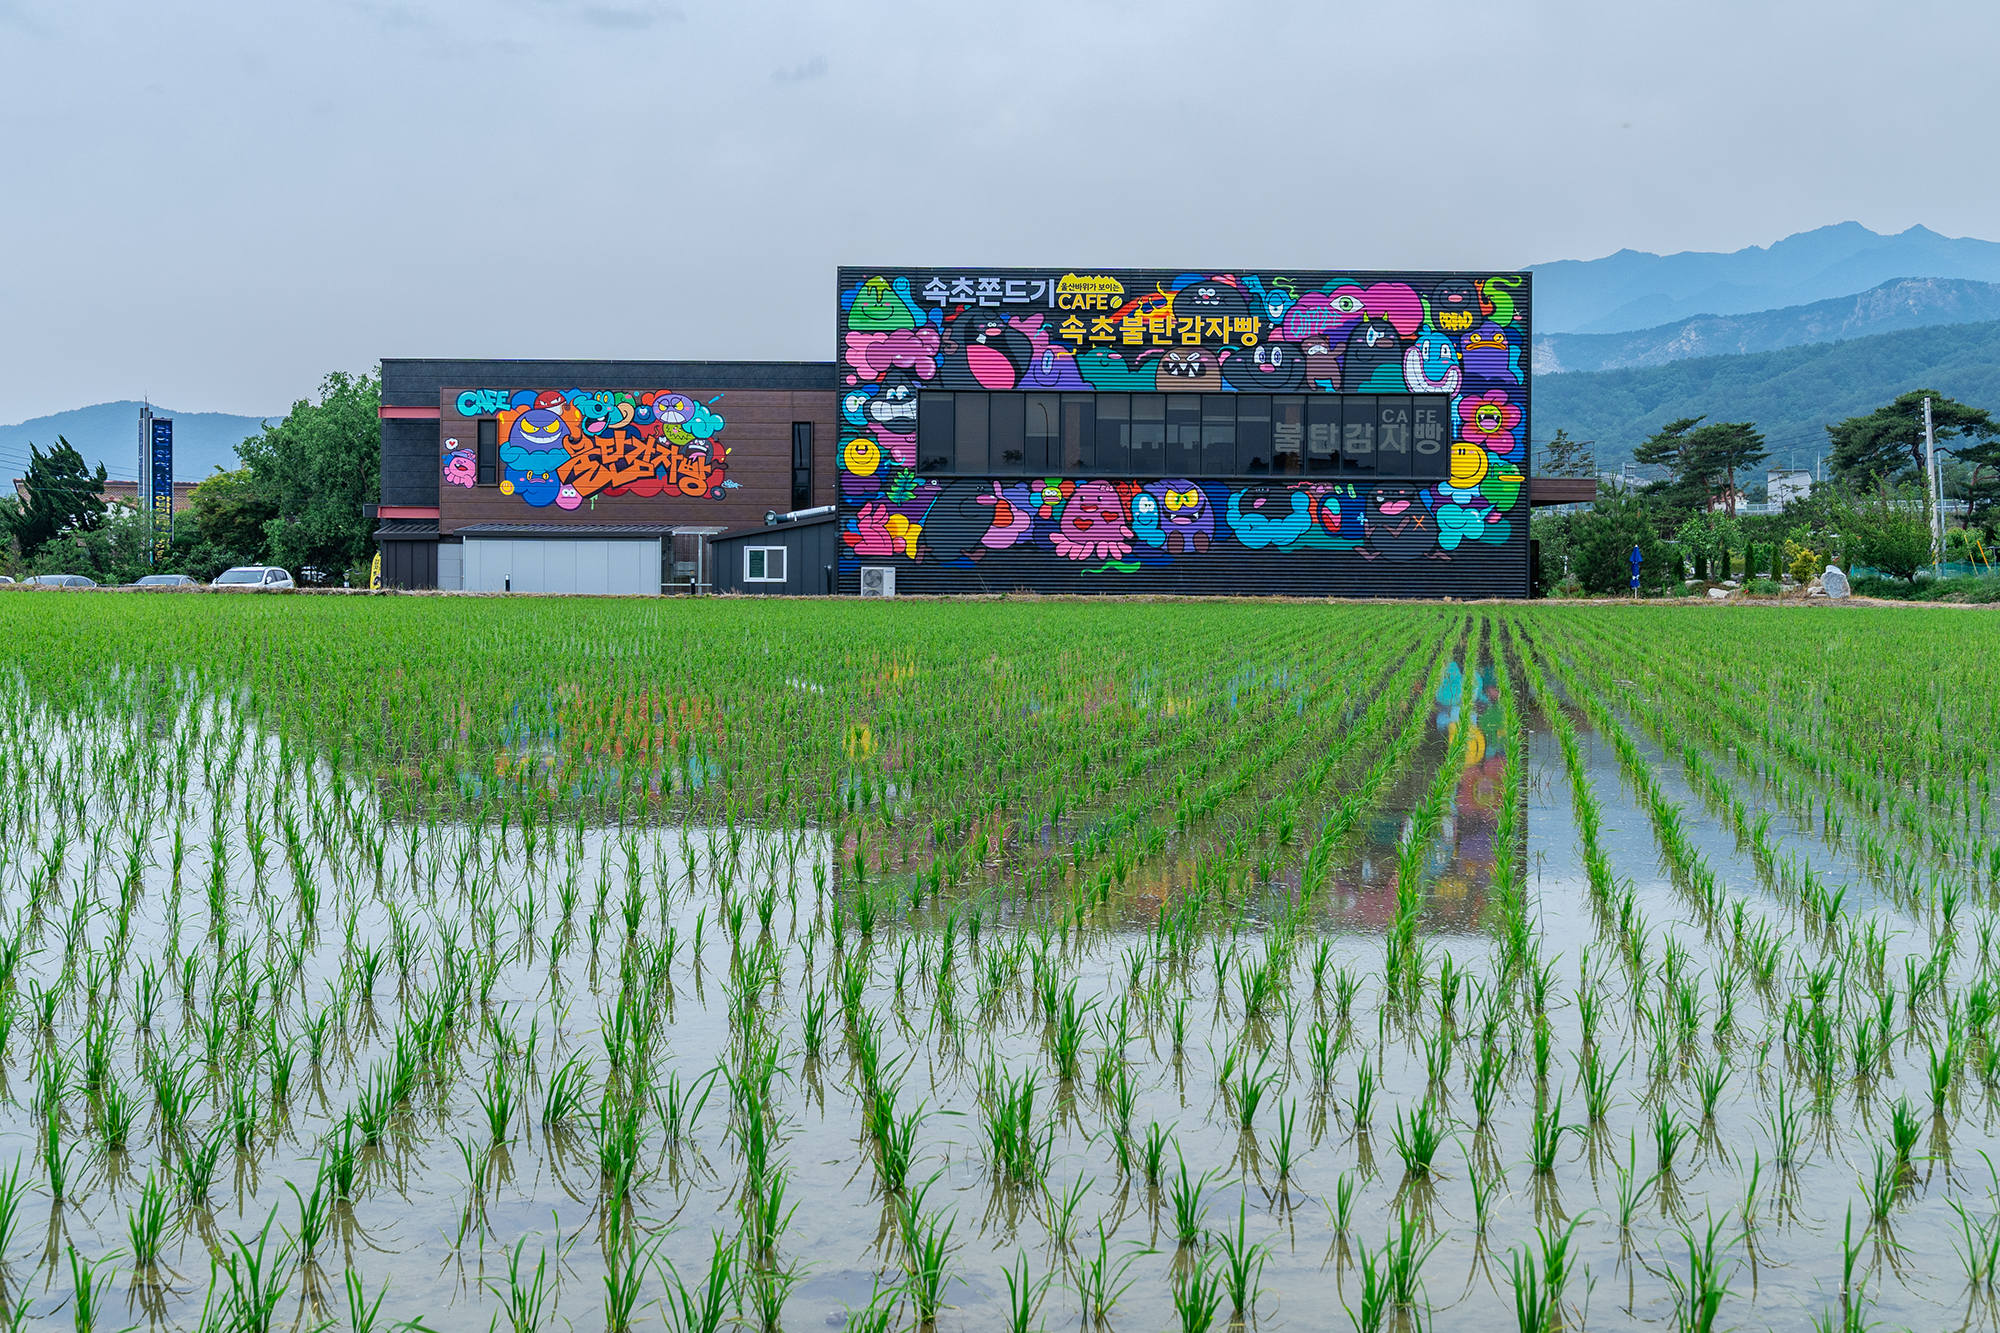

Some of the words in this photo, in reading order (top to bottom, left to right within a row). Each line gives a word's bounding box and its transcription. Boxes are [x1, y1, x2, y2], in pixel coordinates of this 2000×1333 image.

[922, 276, 1055, 308] 속초쫀드기
[1058, 293, 1108, 310] CAFE
[1061, 282, 1097, 291] 울산바위가
[1098, 283, 1120, 292] 보이는
[1058, 314, 1262, 347] 속초불탄감자빵
[456, 388, 511, 417] CAFE
[1381, 409, 1437, 423] CAFE
[1273, 421, 1445, 455] 불탄감자빵
